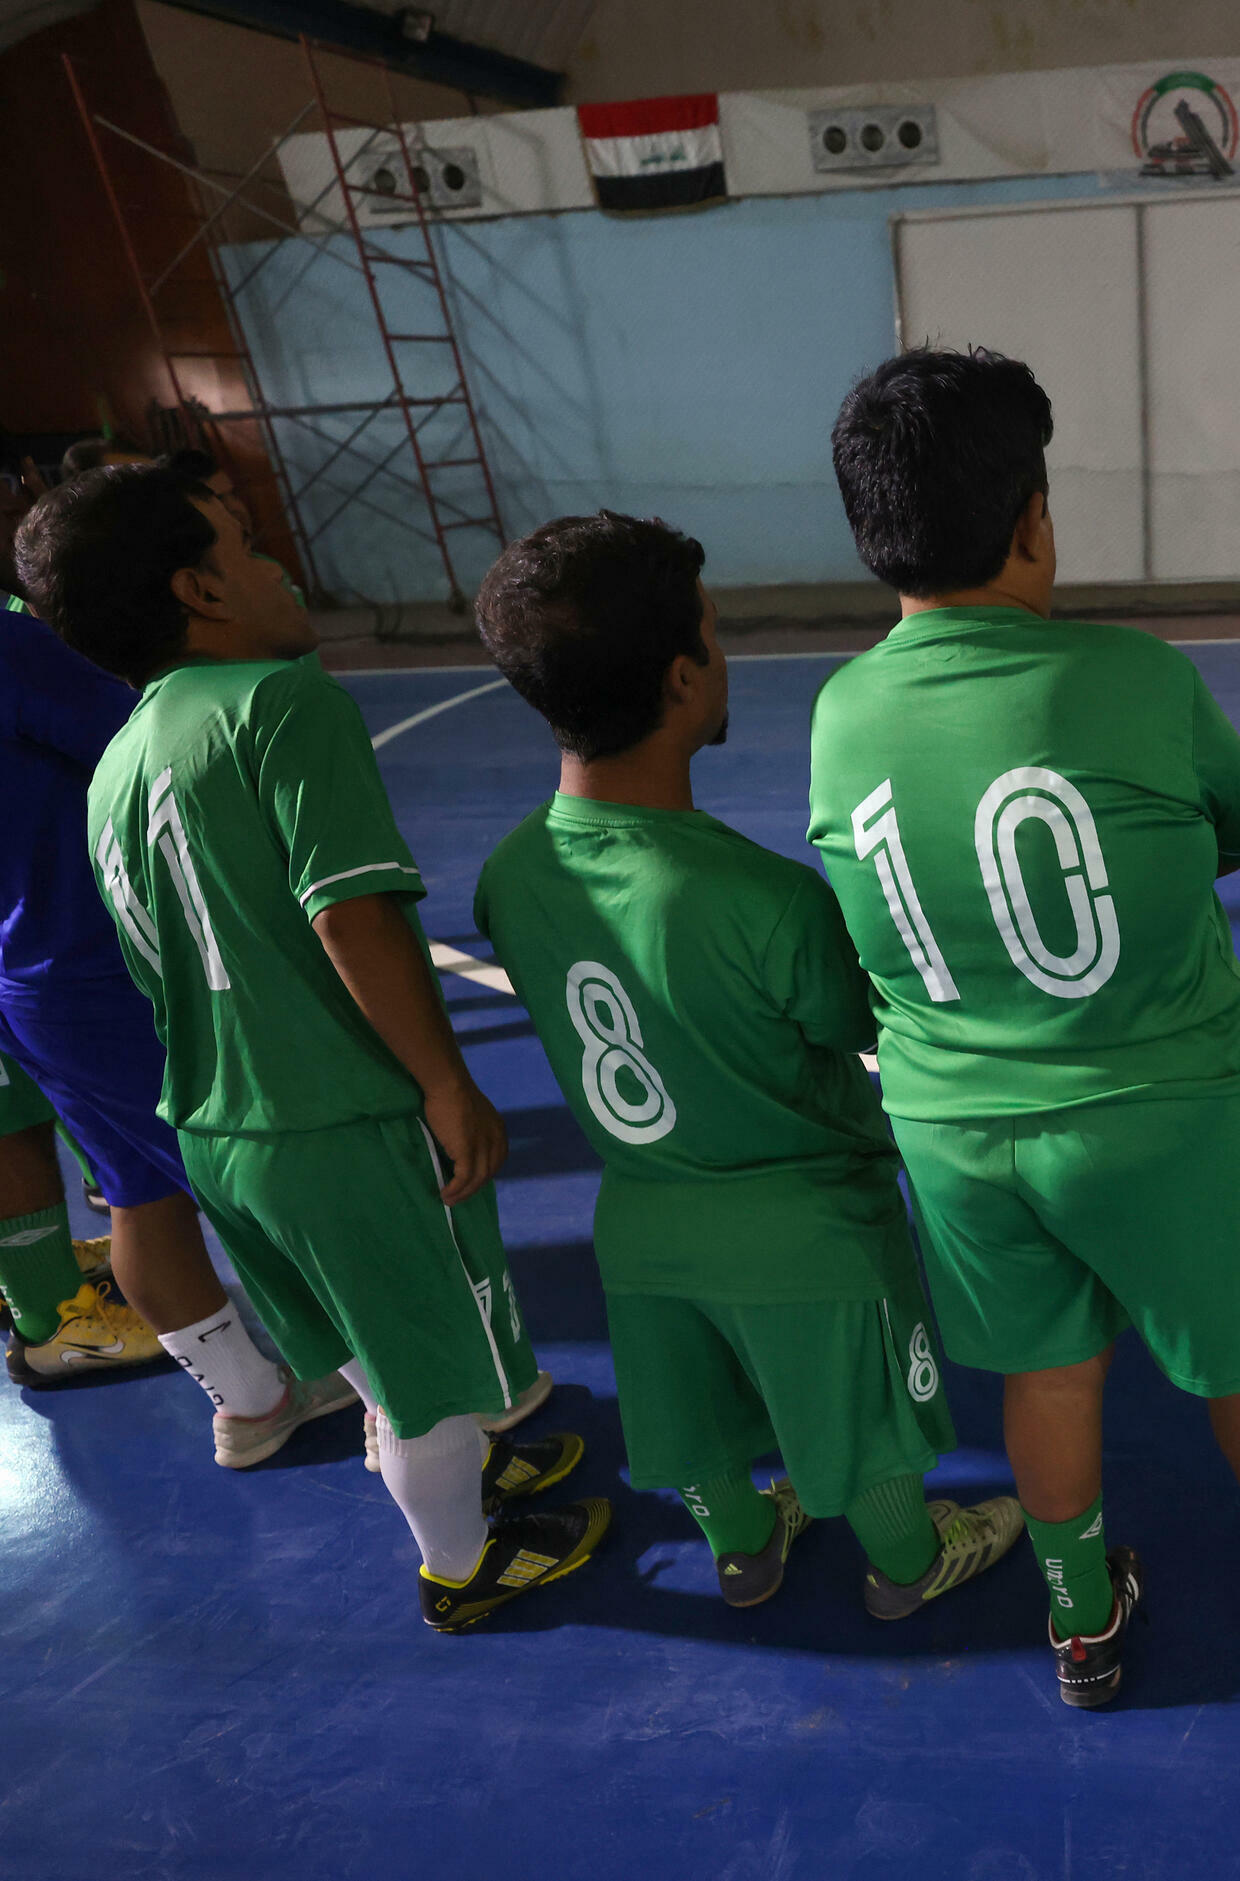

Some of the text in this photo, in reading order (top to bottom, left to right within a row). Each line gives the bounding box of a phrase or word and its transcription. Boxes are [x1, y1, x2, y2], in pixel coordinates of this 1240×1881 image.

[95, 764, 231, 990] 11
[850, 766, 1120, 1001] 10
[566, 960, 677, 1145] 8
[907, 1321, 939, 1402] 8
